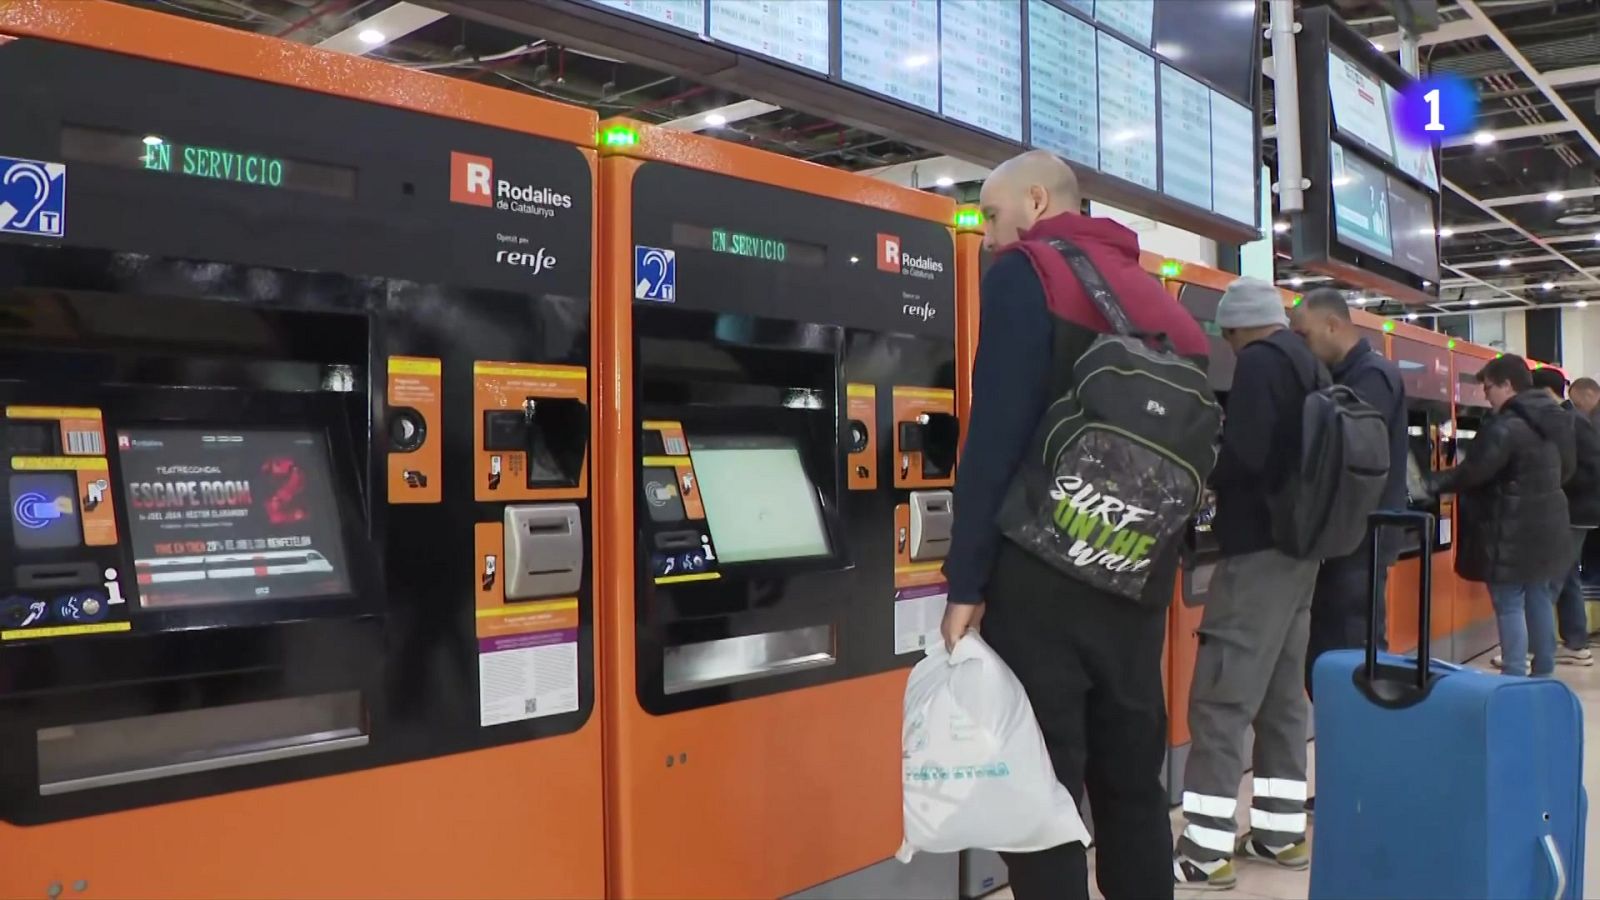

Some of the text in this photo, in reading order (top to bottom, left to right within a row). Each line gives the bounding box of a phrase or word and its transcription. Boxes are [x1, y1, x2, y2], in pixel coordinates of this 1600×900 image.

[145, 143, 282, 186] EN SERVICIO
[467, 162, 492, 196] R
[497, 179, 573, 209] Rodalies
[496, 200, 555, 218] de Catalunya
[712, 230, 785, 262] EN SERVICIO
[885, 239, 900, 265] R
[496, 248, 557, 275] renfe
[902, 252, 944, 273] Rodalies
[903, 301, 937, 322] renfe
[130, 480, 252, 508] ESCAPE ROOM
[263, 457, 308, 524] 2
[1049, 475, 1156, 532] SURF
